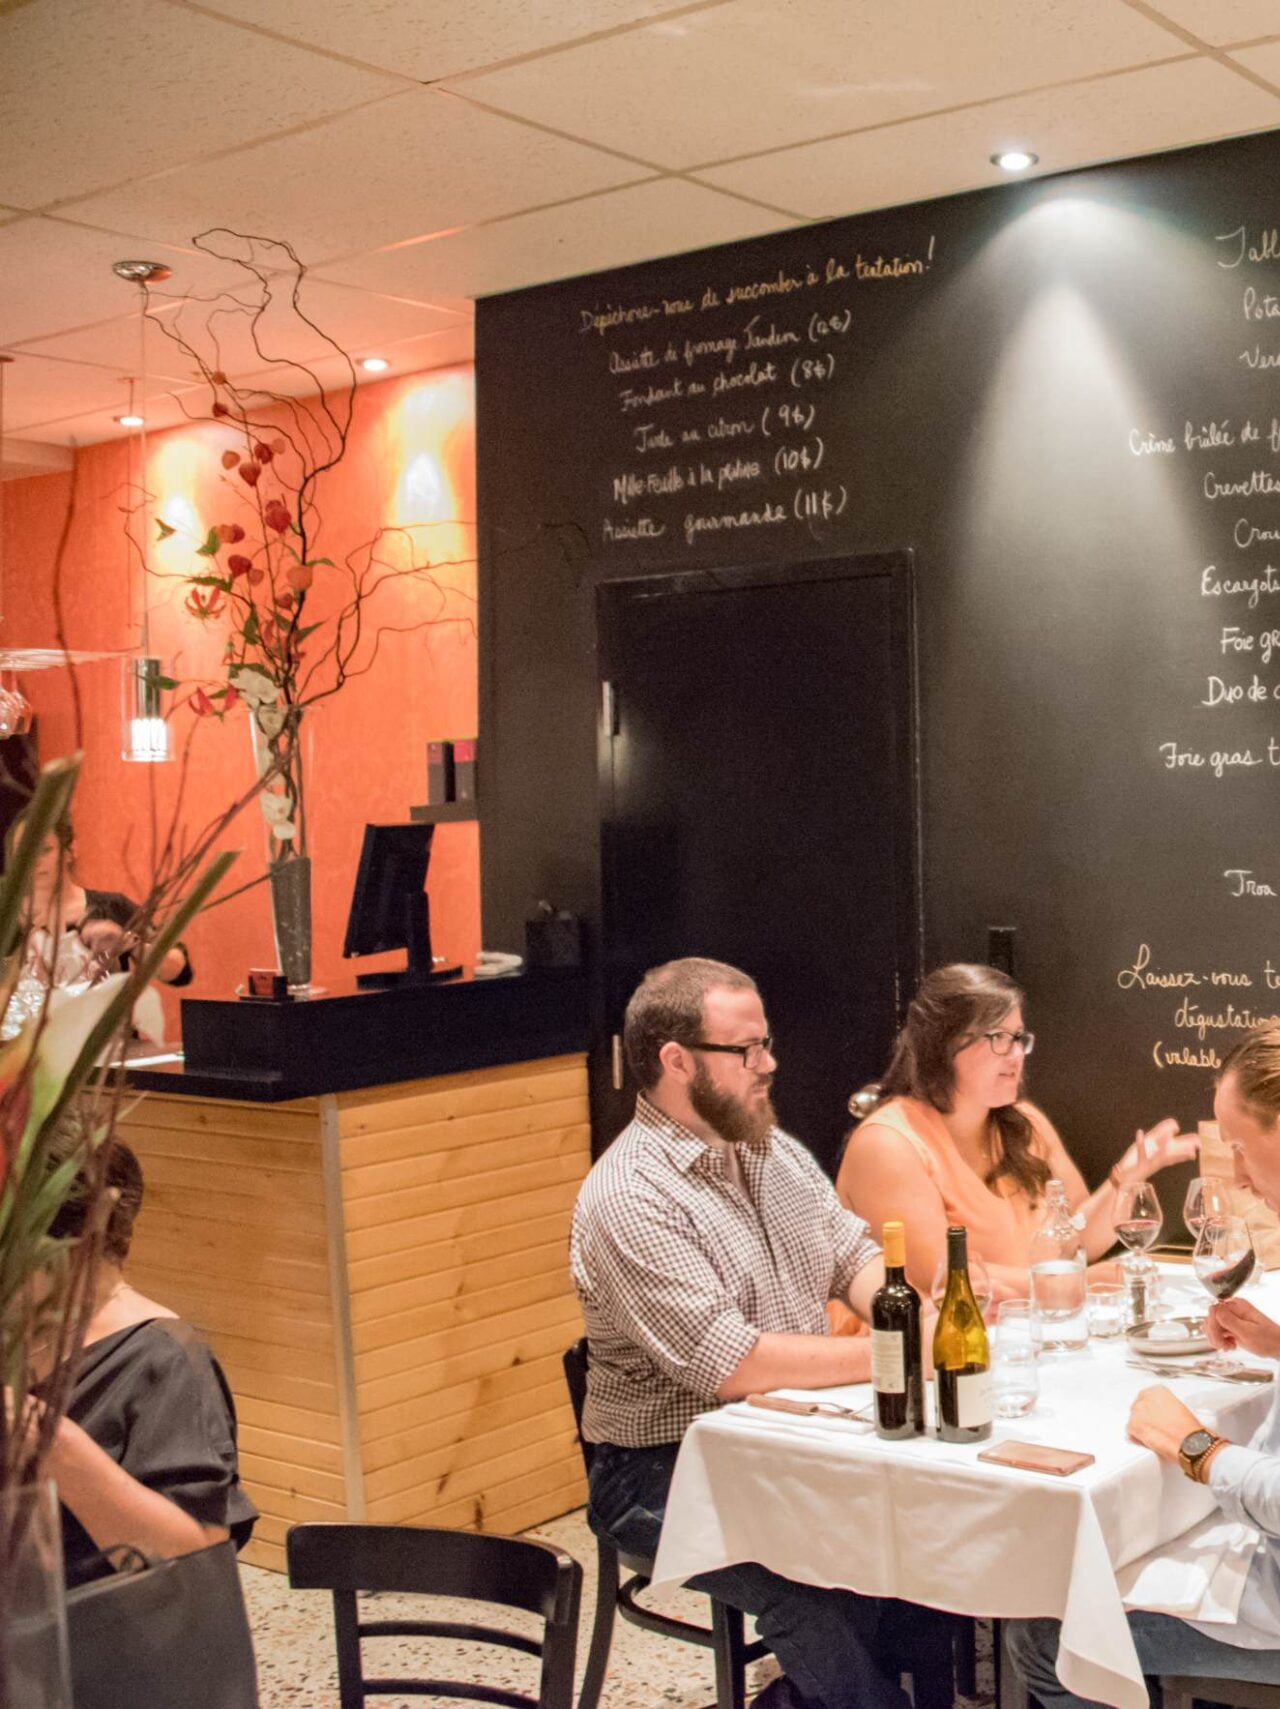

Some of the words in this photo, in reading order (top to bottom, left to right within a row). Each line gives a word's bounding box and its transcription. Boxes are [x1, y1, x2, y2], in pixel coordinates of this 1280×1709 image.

[806, 265, 818, 285] à
[826, 258, 849, 284] la
[712, 362, 776, 397] chocolat
[790, 353, 835, 388] (8$)
[775, 436, 824, 475] (10$)
[1129, 428, 1176, 456] Crème
[1241, 421, 1260, 441] de
[1220, 626, 1254, 654] Foie
[1201, 676, 1243, 706] Duo
[1247, 674, 1268, 702] de
[1159, 742, 1205, 769] Foie
[1209, 749, 1264, 778] gras
